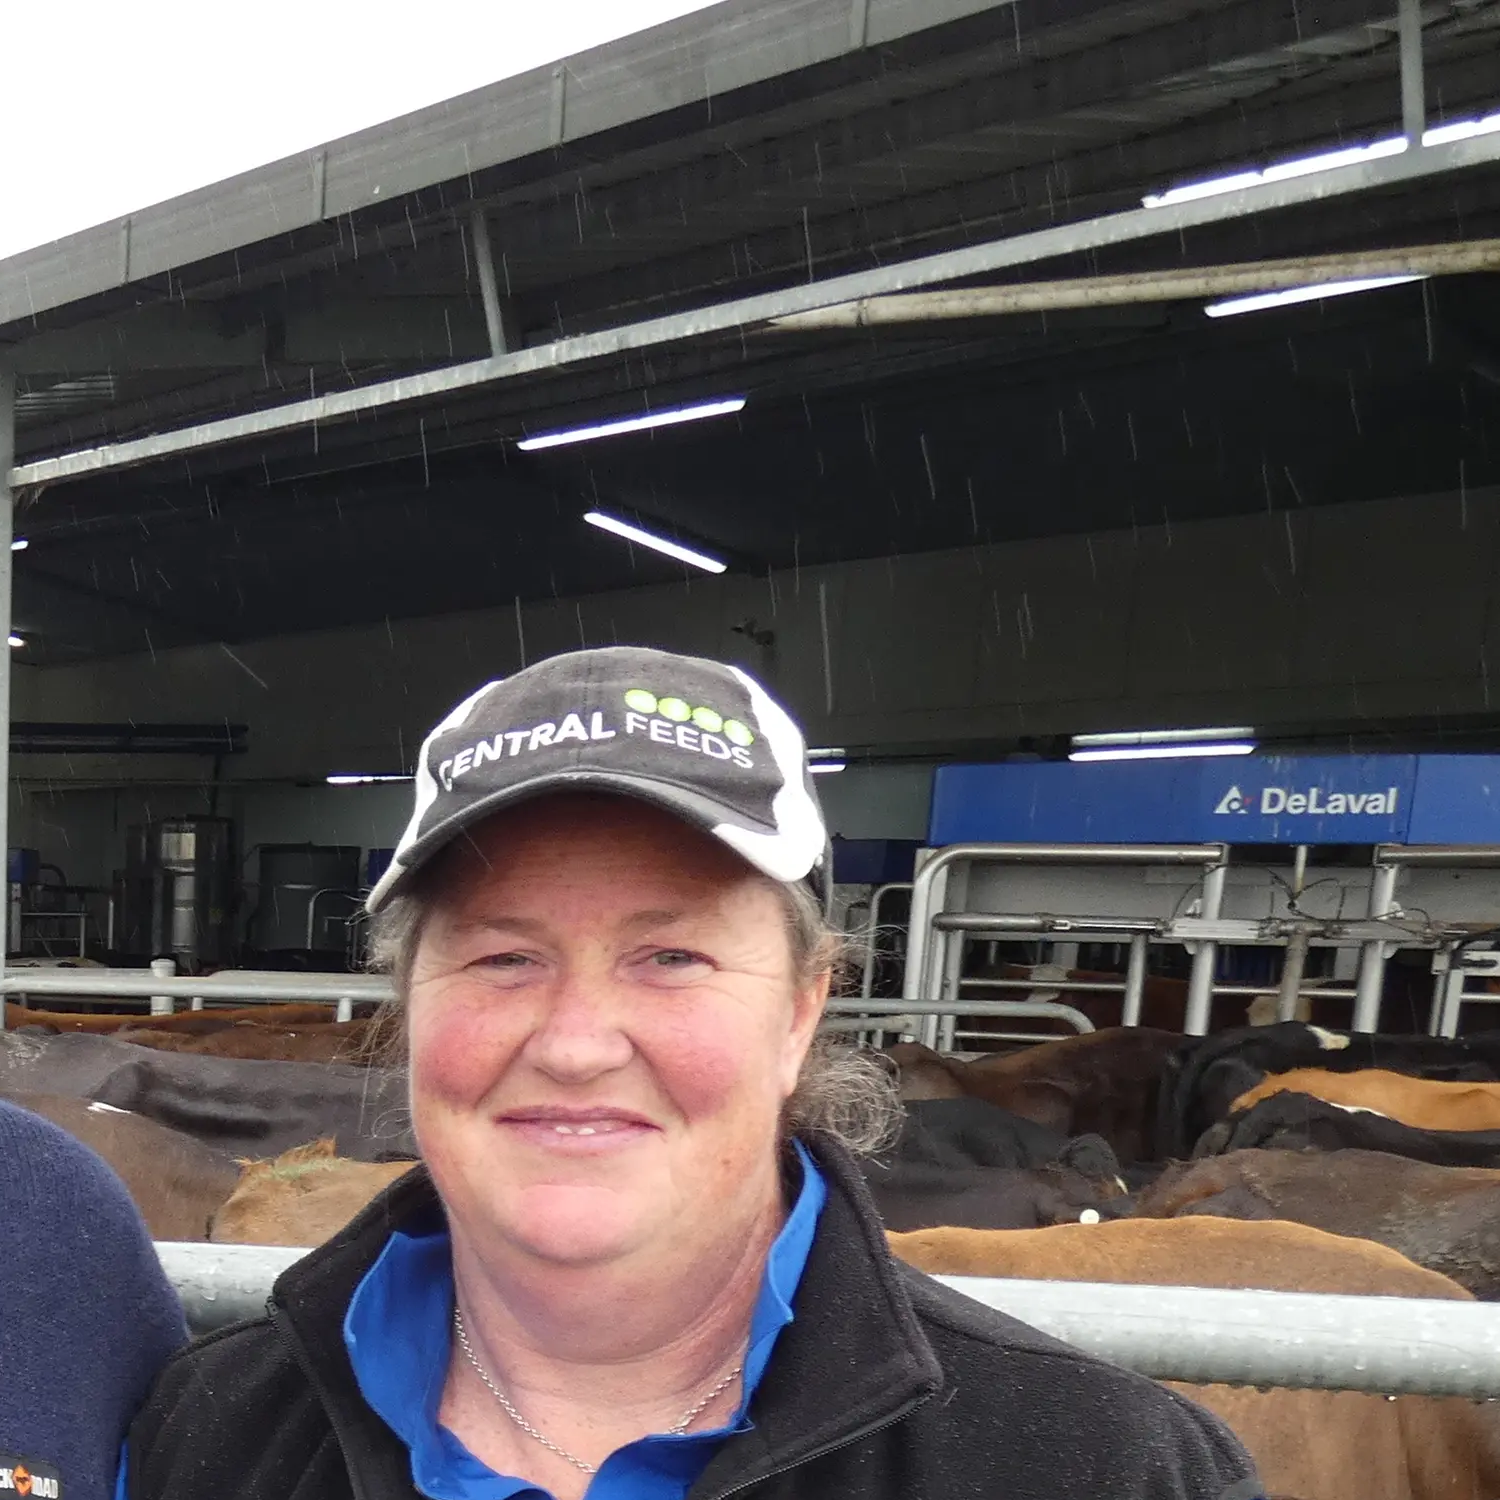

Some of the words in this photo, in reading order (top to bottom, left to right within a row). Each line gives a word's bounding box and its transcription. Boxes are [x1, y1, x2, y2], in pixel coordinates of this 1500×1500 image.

[438, 710, 616, 791] CENTRAL
[626, 711, 754, 769] FEEDS
[1260, 787, 1398, 815] DeLaval
